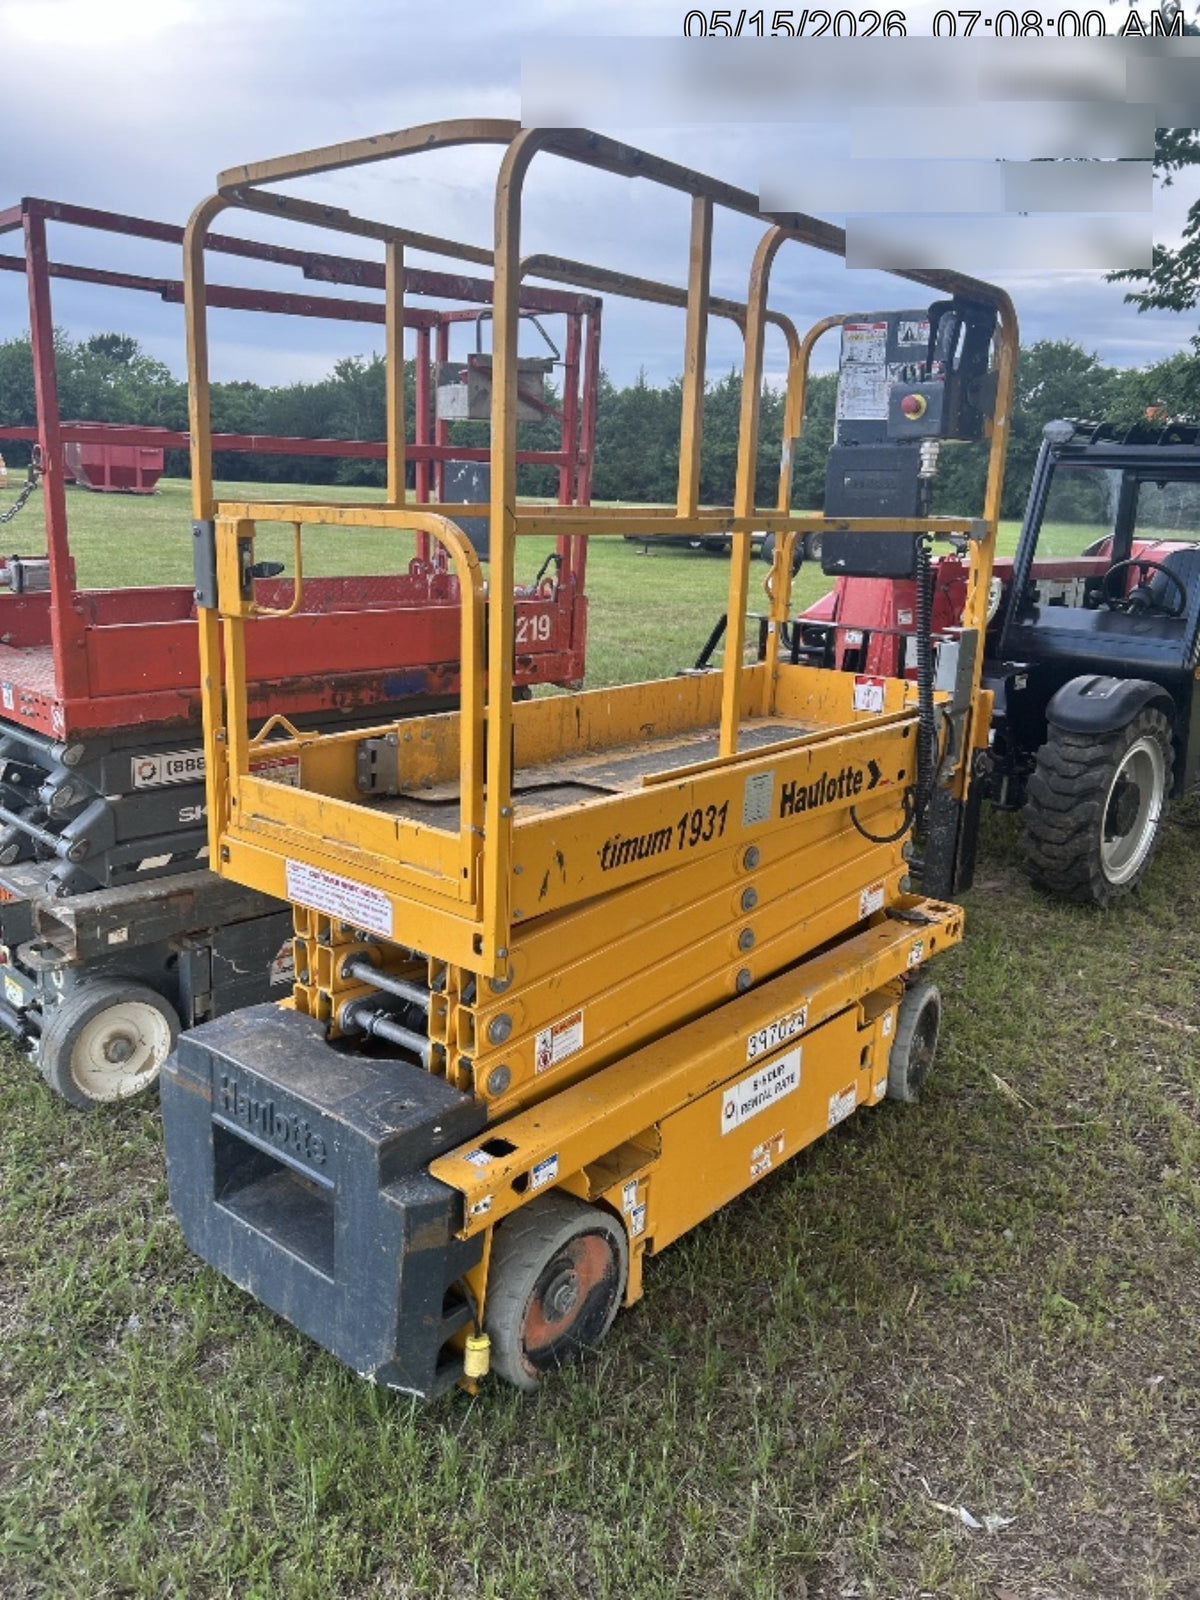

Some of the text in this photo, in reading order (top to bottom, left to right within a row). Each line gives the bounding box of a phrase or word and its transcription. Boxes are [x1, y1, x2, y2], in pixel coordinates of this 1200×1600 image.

[515, 614, 551, 643] 219
[779, 766, 863, 818] Haulotte
[677, 800, 729, 850] 1931
[220, 1074, 328, 1165] Haulotte
